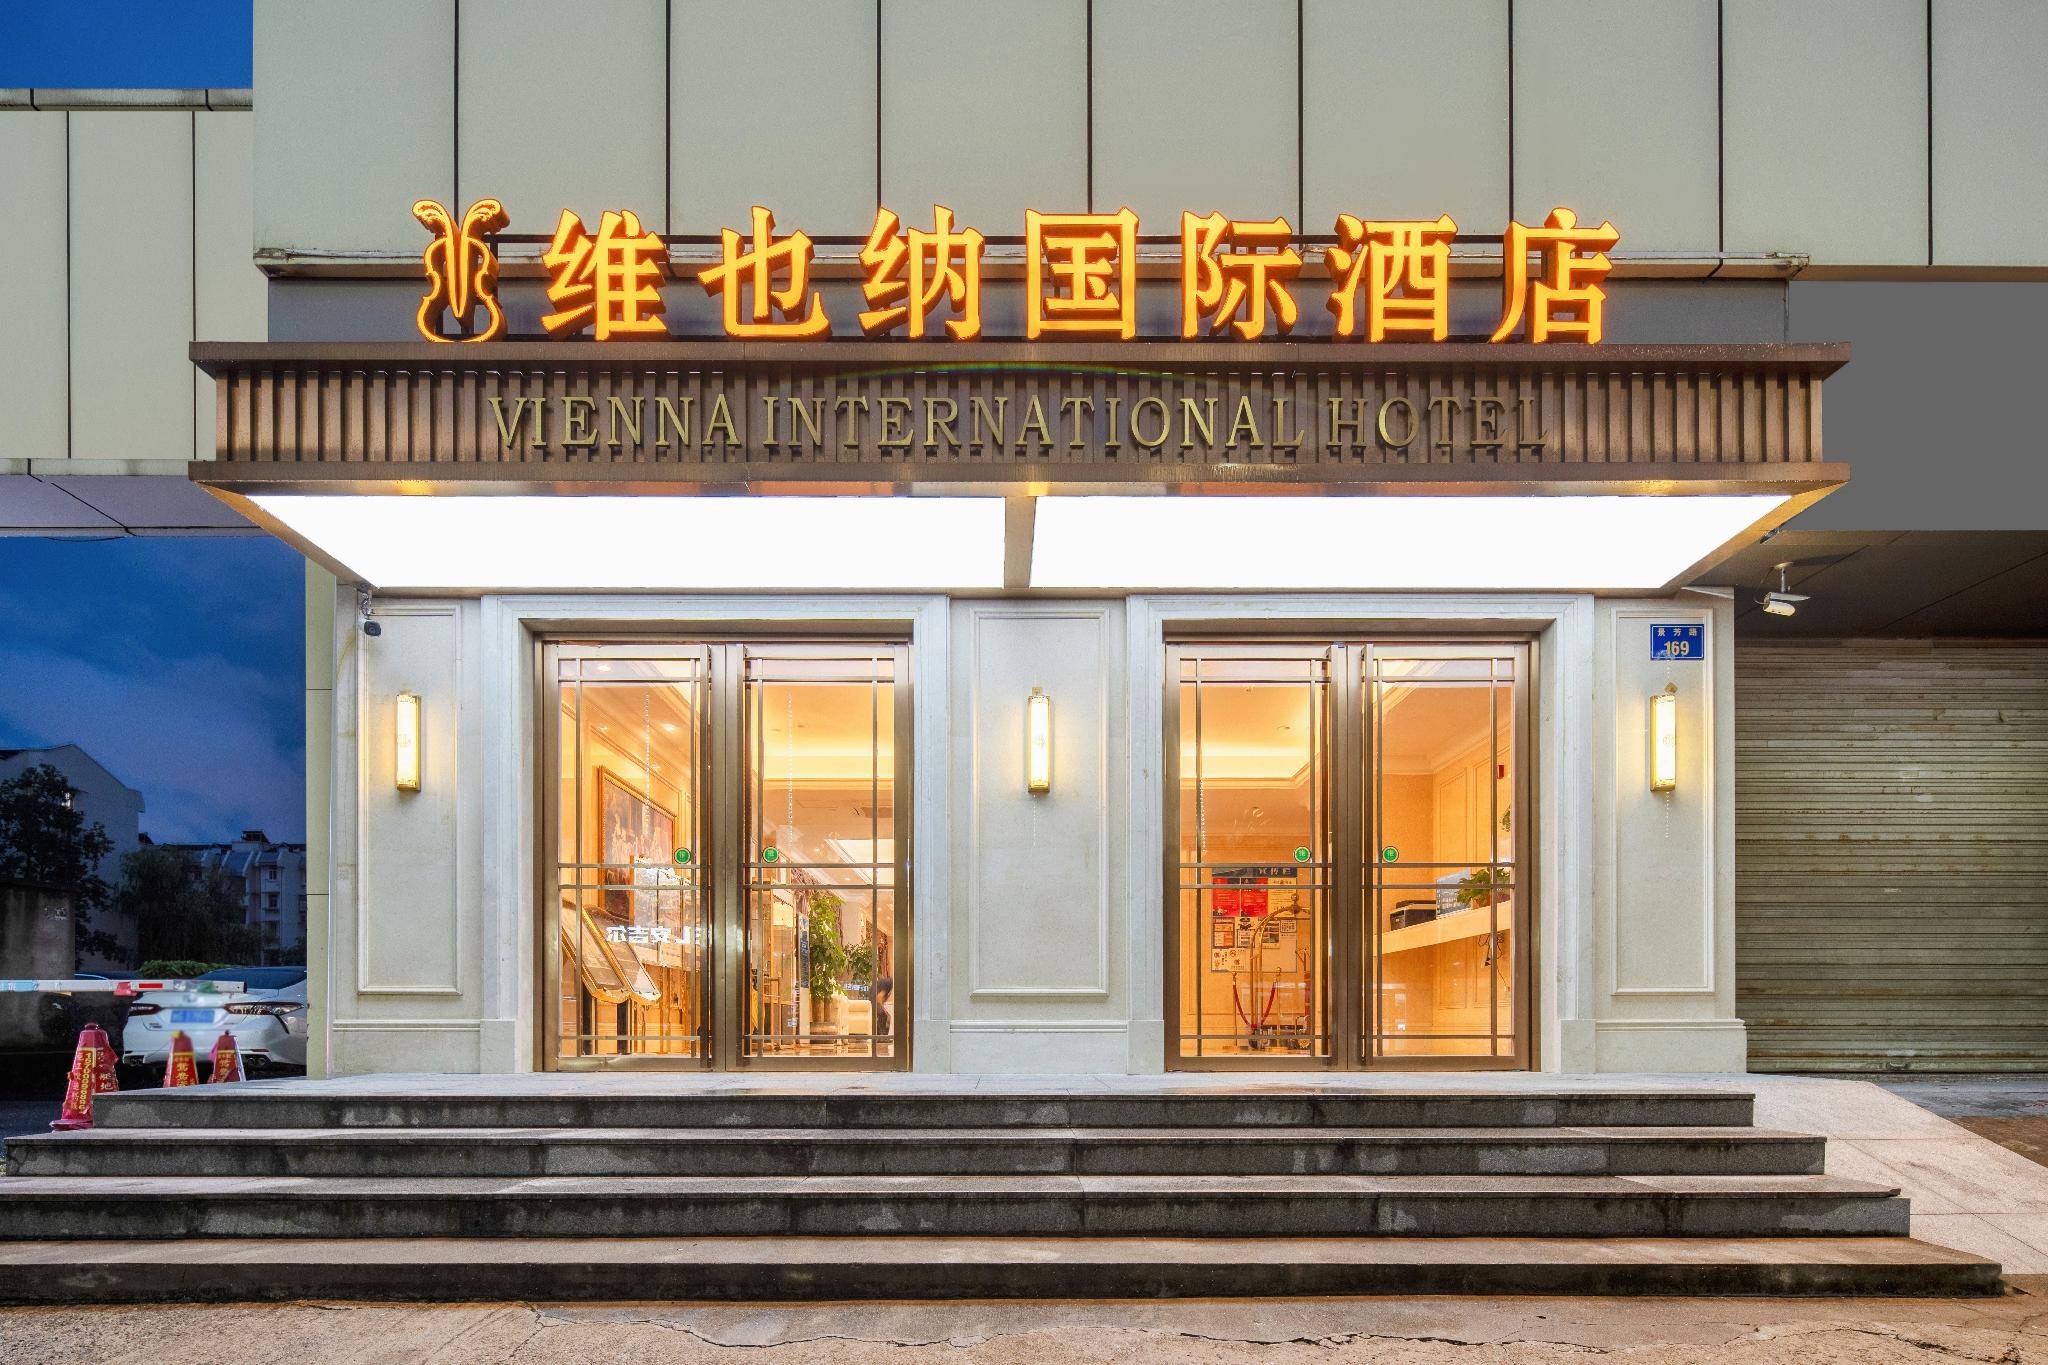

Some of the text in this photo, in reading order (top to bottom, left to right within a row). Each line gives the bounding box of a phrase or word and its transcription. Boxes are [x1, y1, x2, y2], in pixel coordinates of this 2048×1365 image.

[541, 204, 1621, 343] 维也纳国际酒店
[488, 394, 1548, 449] VIENNA INTERNATIONAL HOTEL
[1663, 640, 1690, 656] 169
